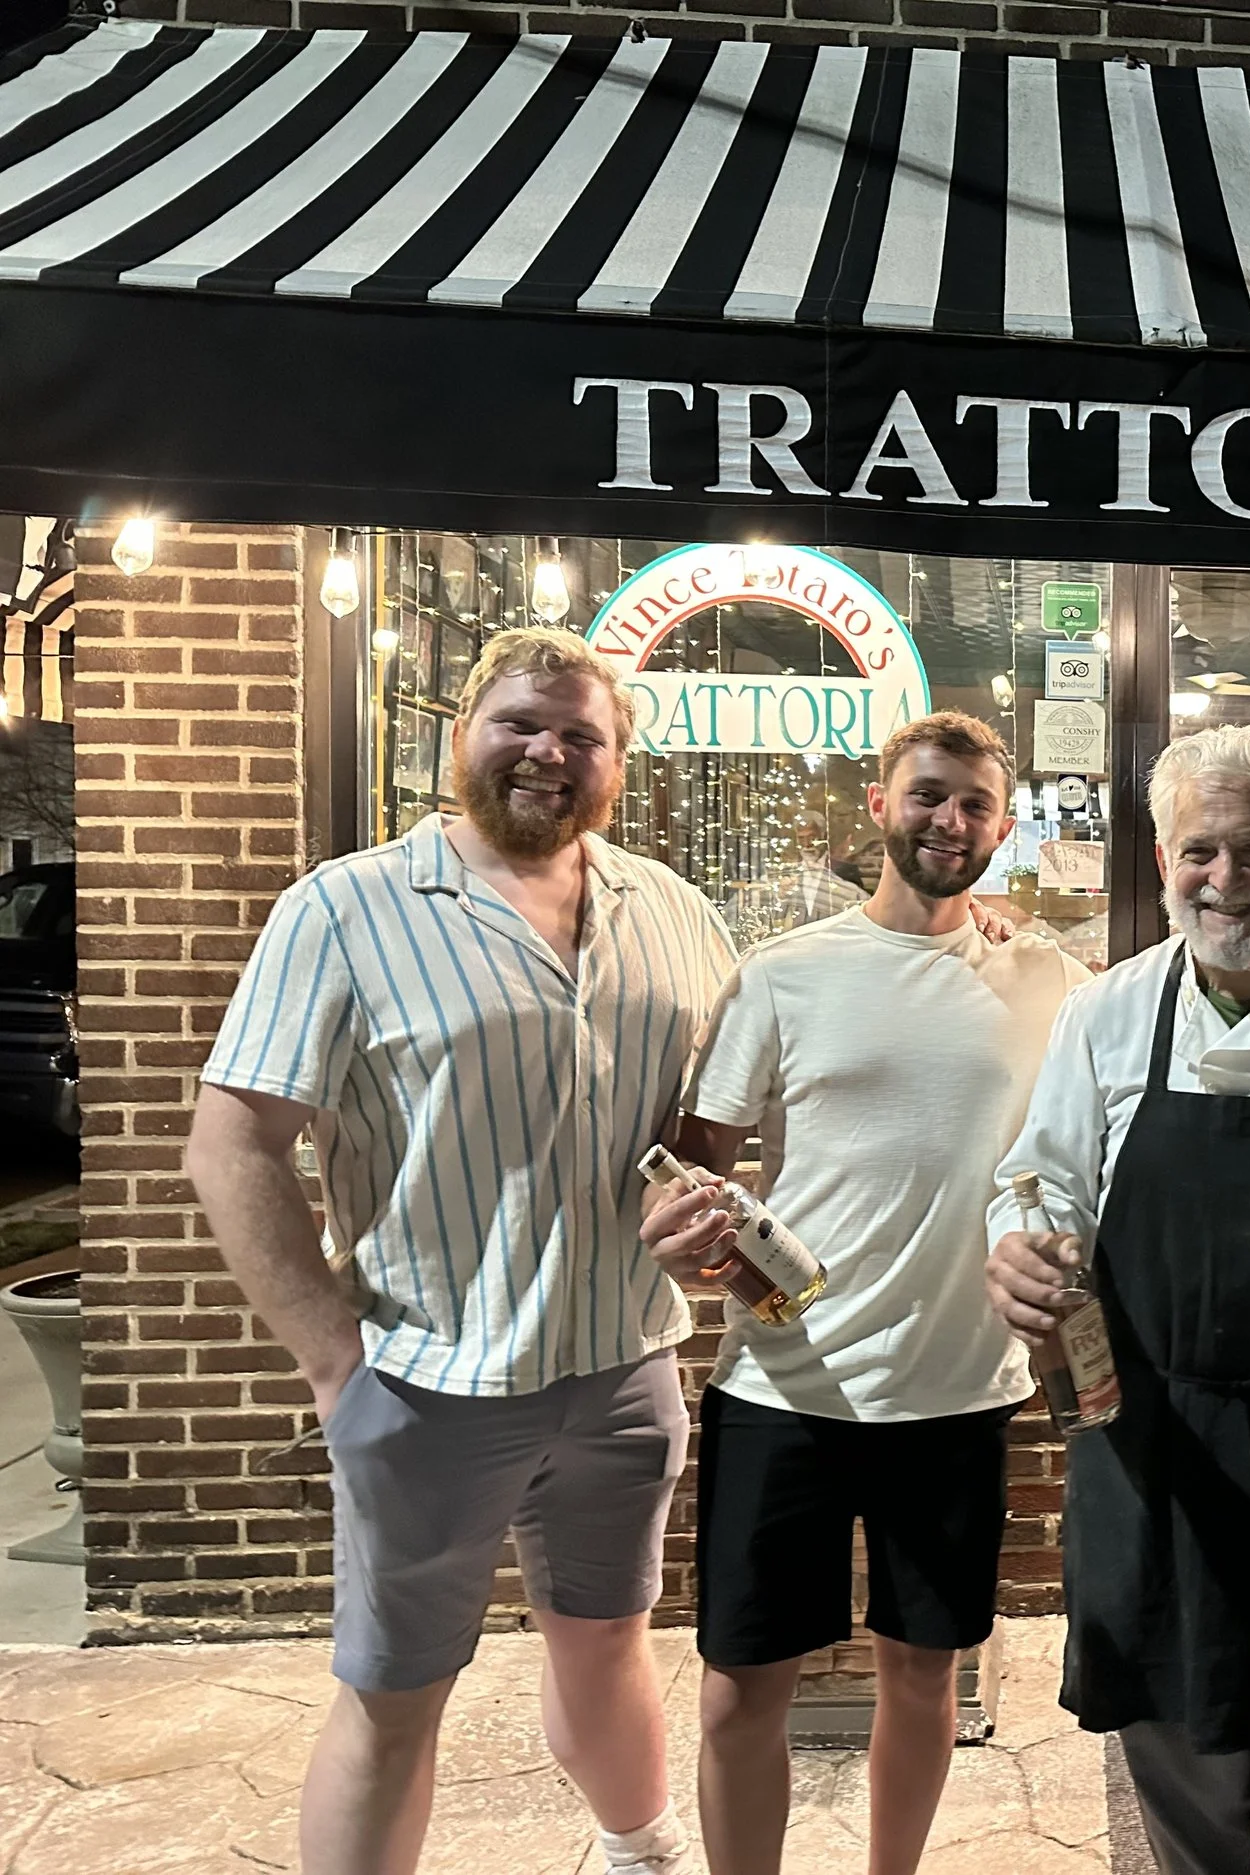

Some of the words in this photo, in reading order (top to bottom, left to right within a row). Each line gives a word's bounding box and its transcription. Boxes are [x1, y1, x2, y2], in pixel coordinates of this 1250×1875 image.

[594, 567, 718, 657] Vince
[1052, 680, 1095, 689] tripadvisor
[622, 682, 911, 760] RATTORIA
[1062, 727, 1101, 736] CONSHY
[1048, 756, 1090, 765] MEMBER
